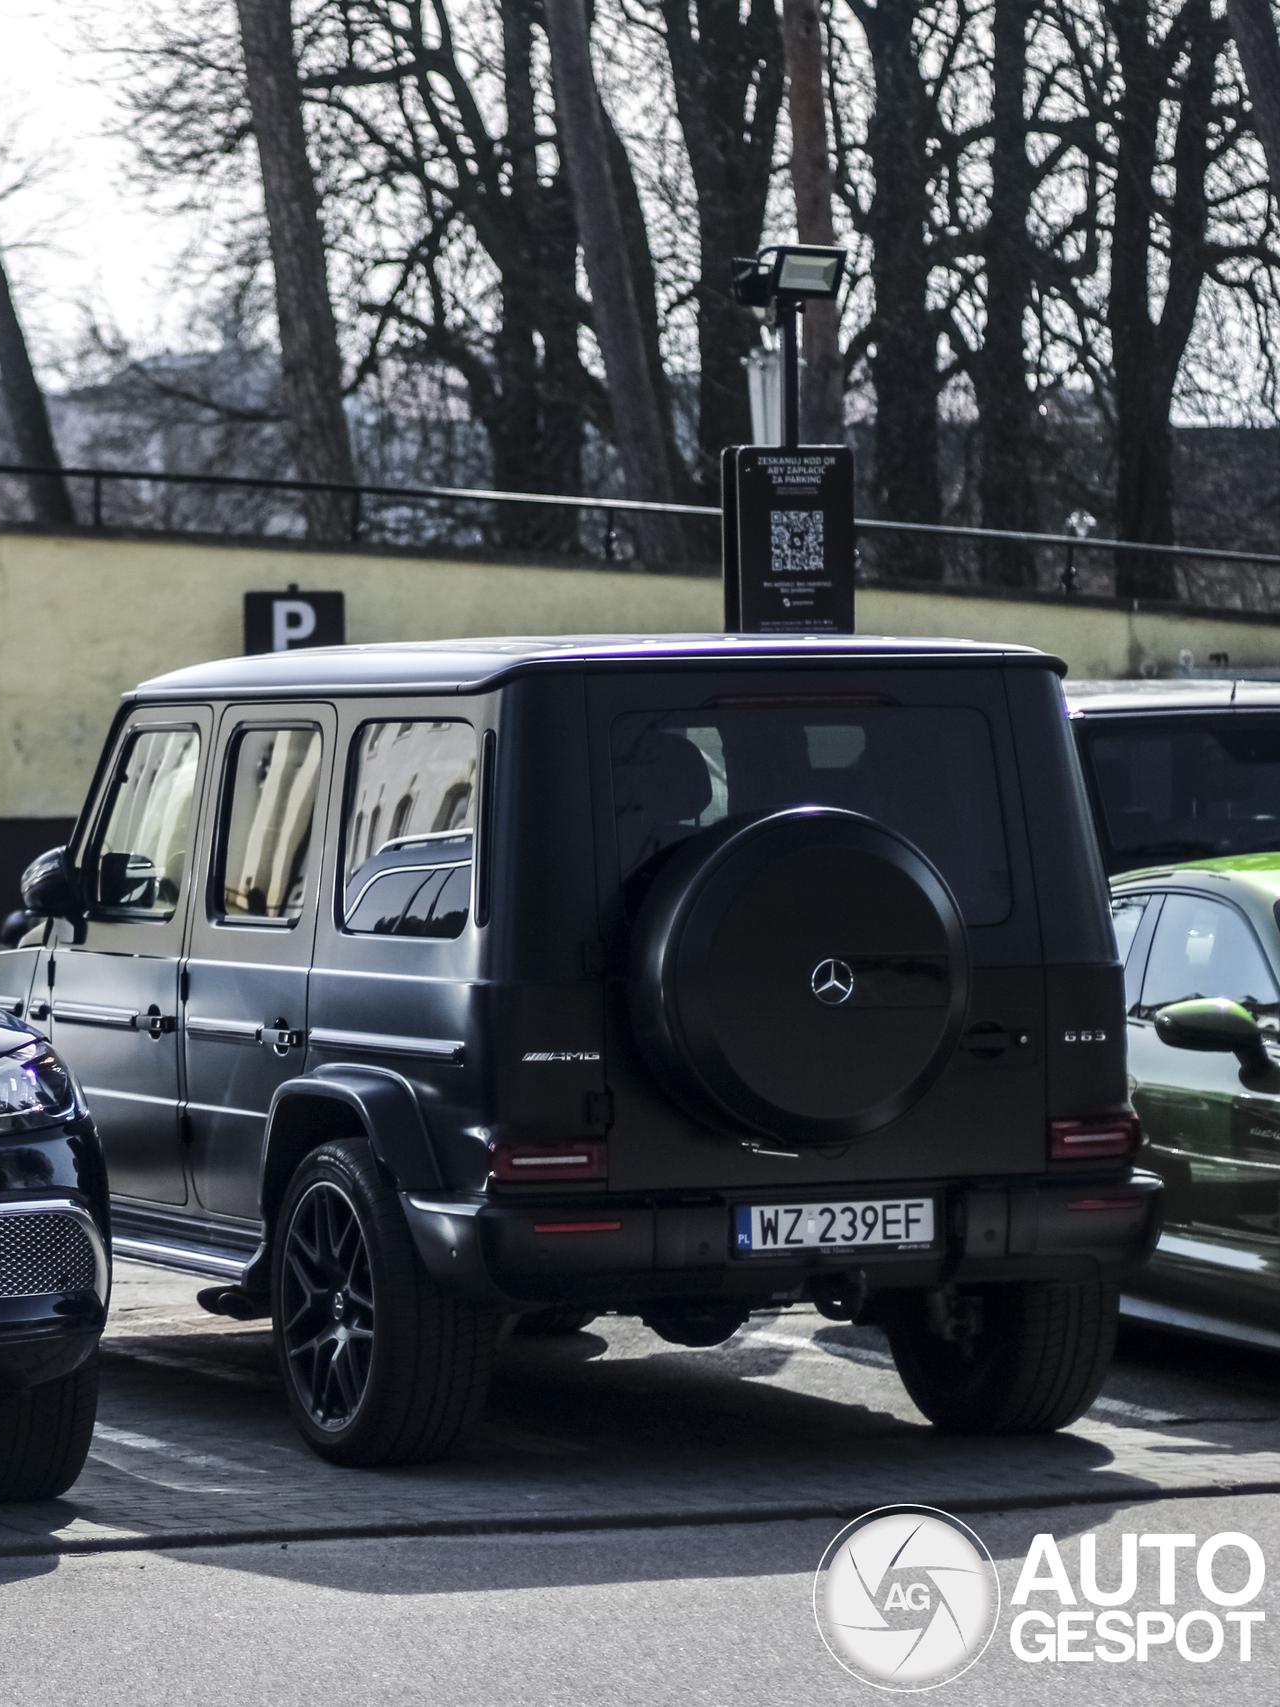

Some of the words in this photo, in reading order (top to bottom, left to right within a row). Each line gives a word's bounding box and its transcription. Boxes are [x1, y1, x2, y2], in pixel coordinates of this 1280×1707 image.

[758, 457, 801, 465] ZESKANUJ
[803, 457, 821, 465] KOD
[823, 457, 836, 466] QR
[767, 466, 784, 474] ABY
[772, 475, 784, 484] ZA
[785, 475, 822, 484] PARKING
[273, 600, 317, 651] P
[759, 1208, 804, 1246] WZ
[818, 1203, 924, 1243] 239EF
[738, 1234, 750, 1244] PL
